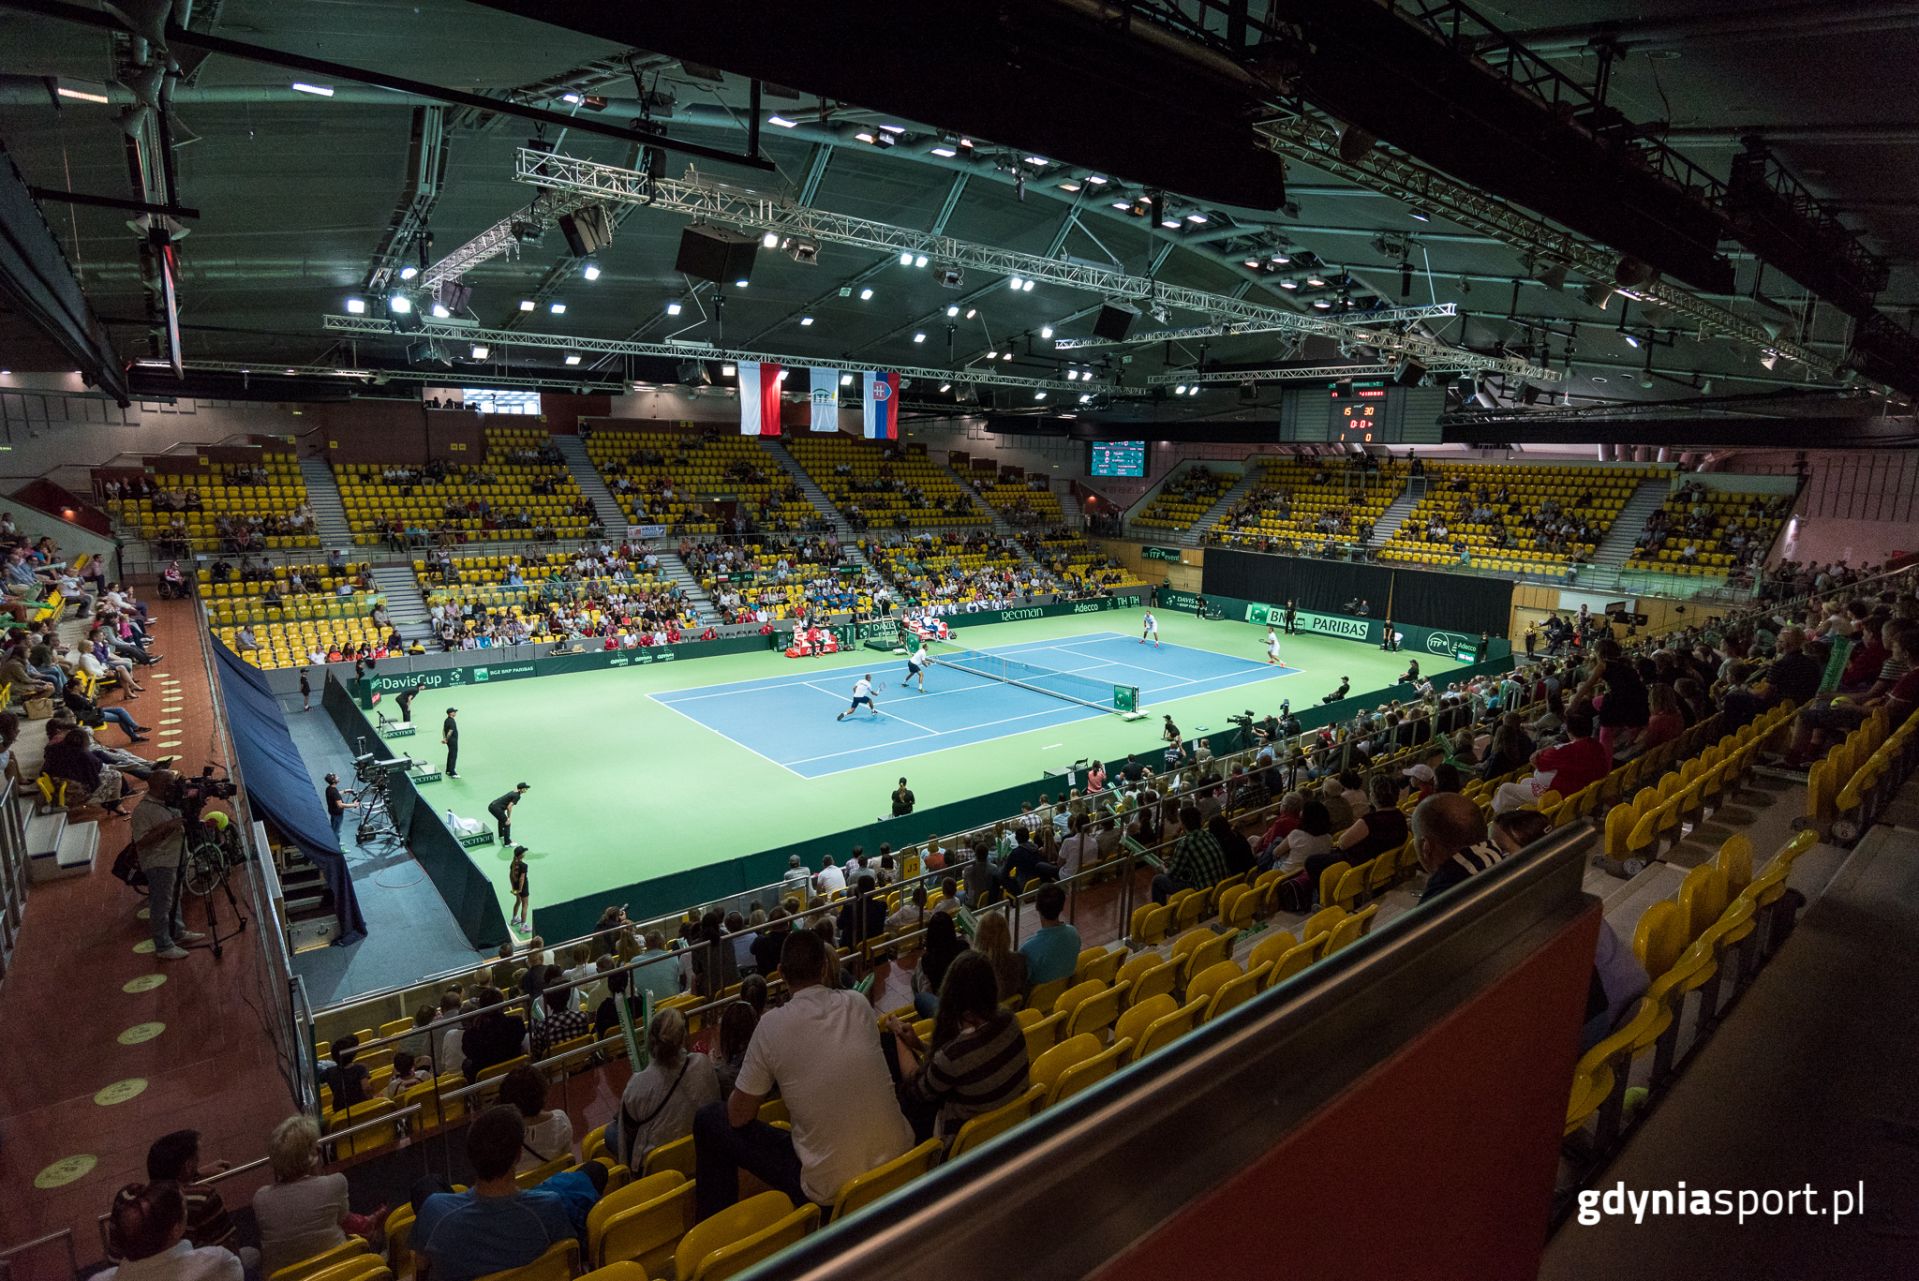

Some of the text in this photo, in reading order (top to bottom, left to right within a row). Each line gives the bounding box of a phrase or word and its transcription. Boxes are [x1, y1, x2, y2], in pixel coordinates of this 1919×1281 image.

[1364, 407, 1374, 416] 30
[1365, 433, 1372, 441] 0
[1074, 603, 1098, 613] Adecco
[1312, 617, 1367, 637] PARIBAS
